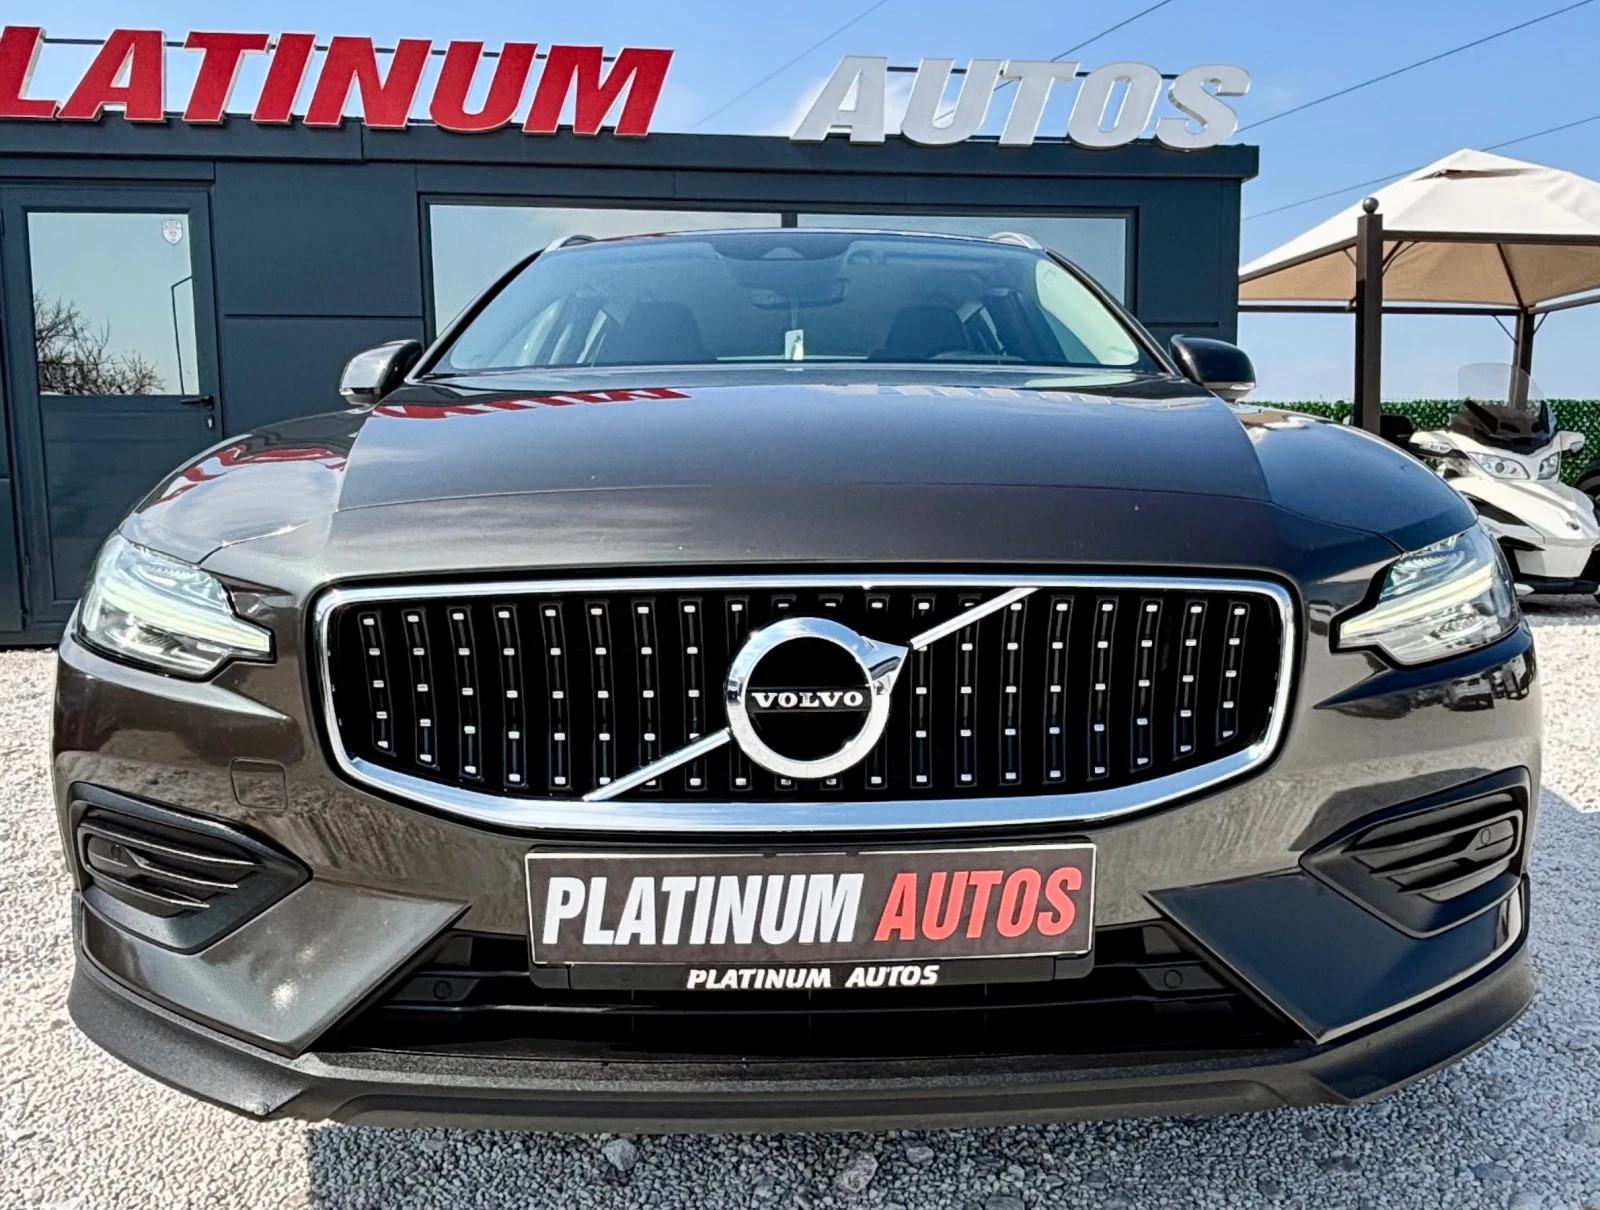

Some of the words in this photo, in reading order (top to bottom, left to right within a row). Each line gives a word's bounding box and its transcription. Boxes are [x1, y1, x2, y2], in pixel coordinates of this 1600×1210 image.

[790, 55, 1251, 150] AUTOS
[751, 691, 864, 708] VOLVO
[542, 873, 864, 946] PLATINUM
[874, 867, 1082, 941] AUTOS
[686, 968, 832, 989] PLATINUM
[845, 965, 940, 988] AUTOS
